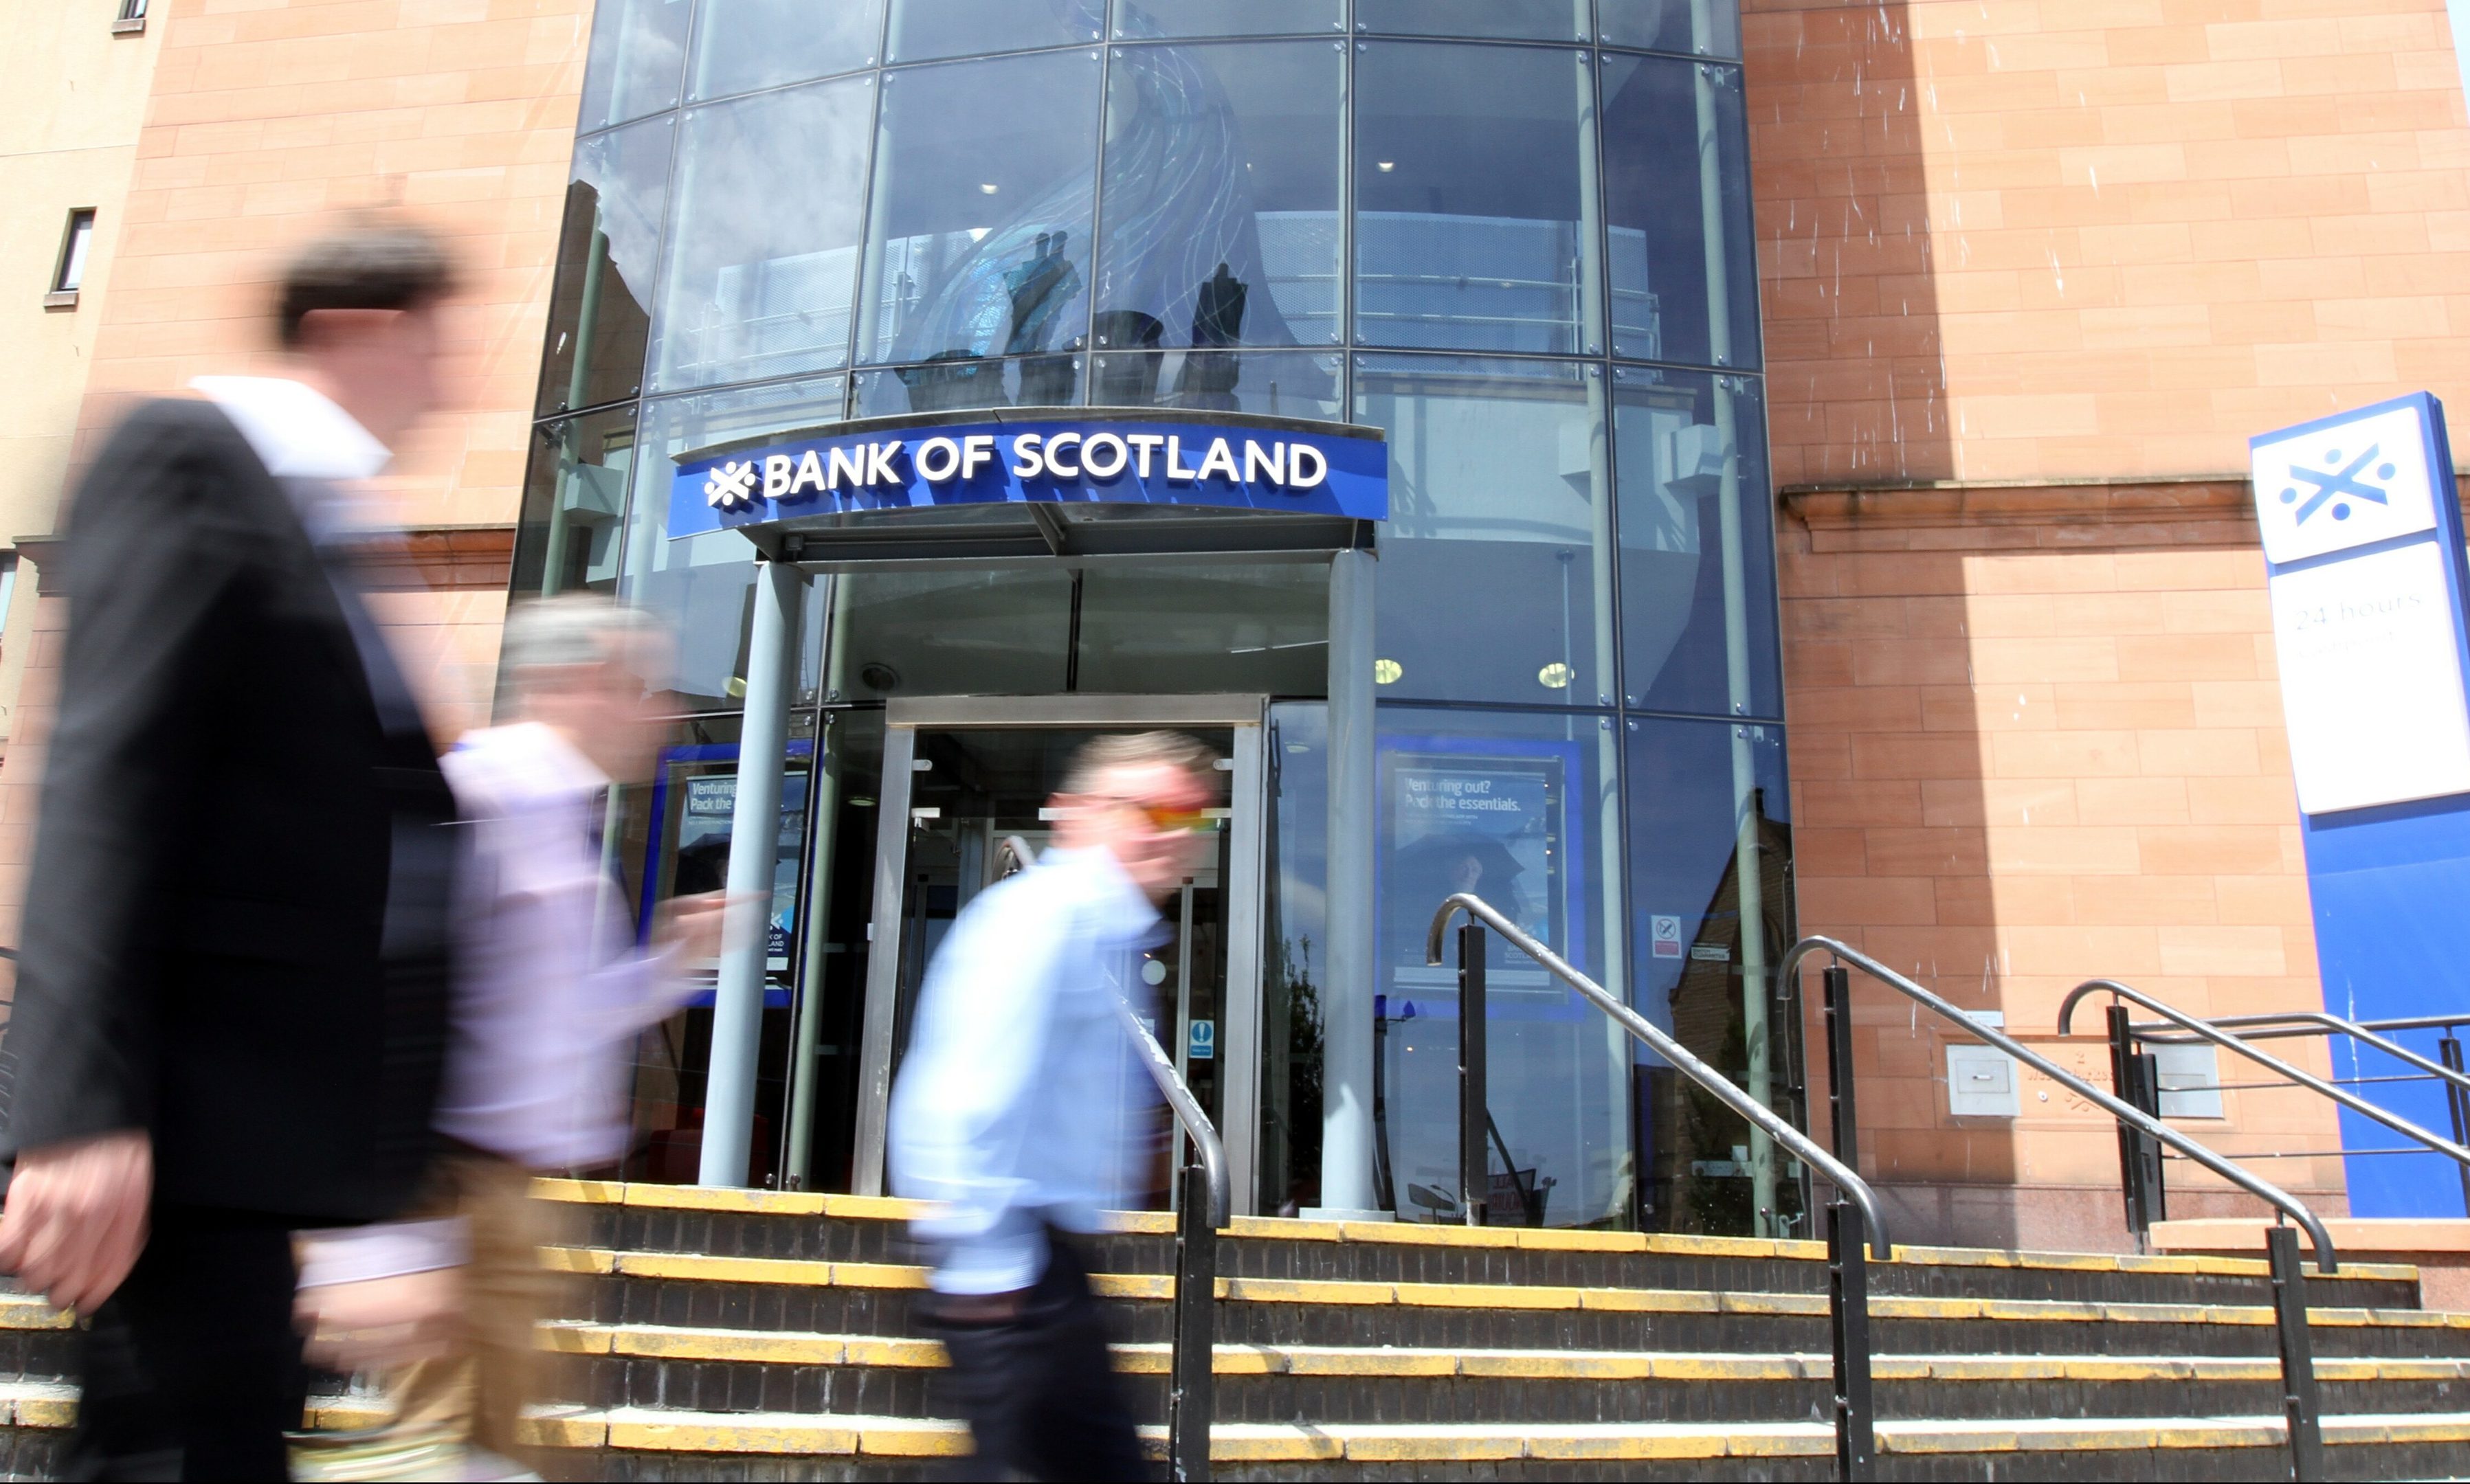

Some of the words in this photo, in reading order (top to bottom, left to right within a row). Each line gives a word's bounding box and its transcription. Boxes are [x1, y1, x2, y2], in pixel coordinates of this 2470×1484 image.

[763, 441, 902, 497] BANK
[915, 435, 995, 482] OF
[1012, 432, 1327, 487] SCOTLAND
[2295, 606, 2327, 631] 24
[2339, 594, 2421, 621] hours
[692, 782, 737, 798] Venturing
[1465, 780, 1491, 794] out?
[691, 798, 713, 810] Pack
[715, 797, 732, 809] the
[1434, 795, 1456, 809] the
[1458, 797, 1521, 812] essentials.
